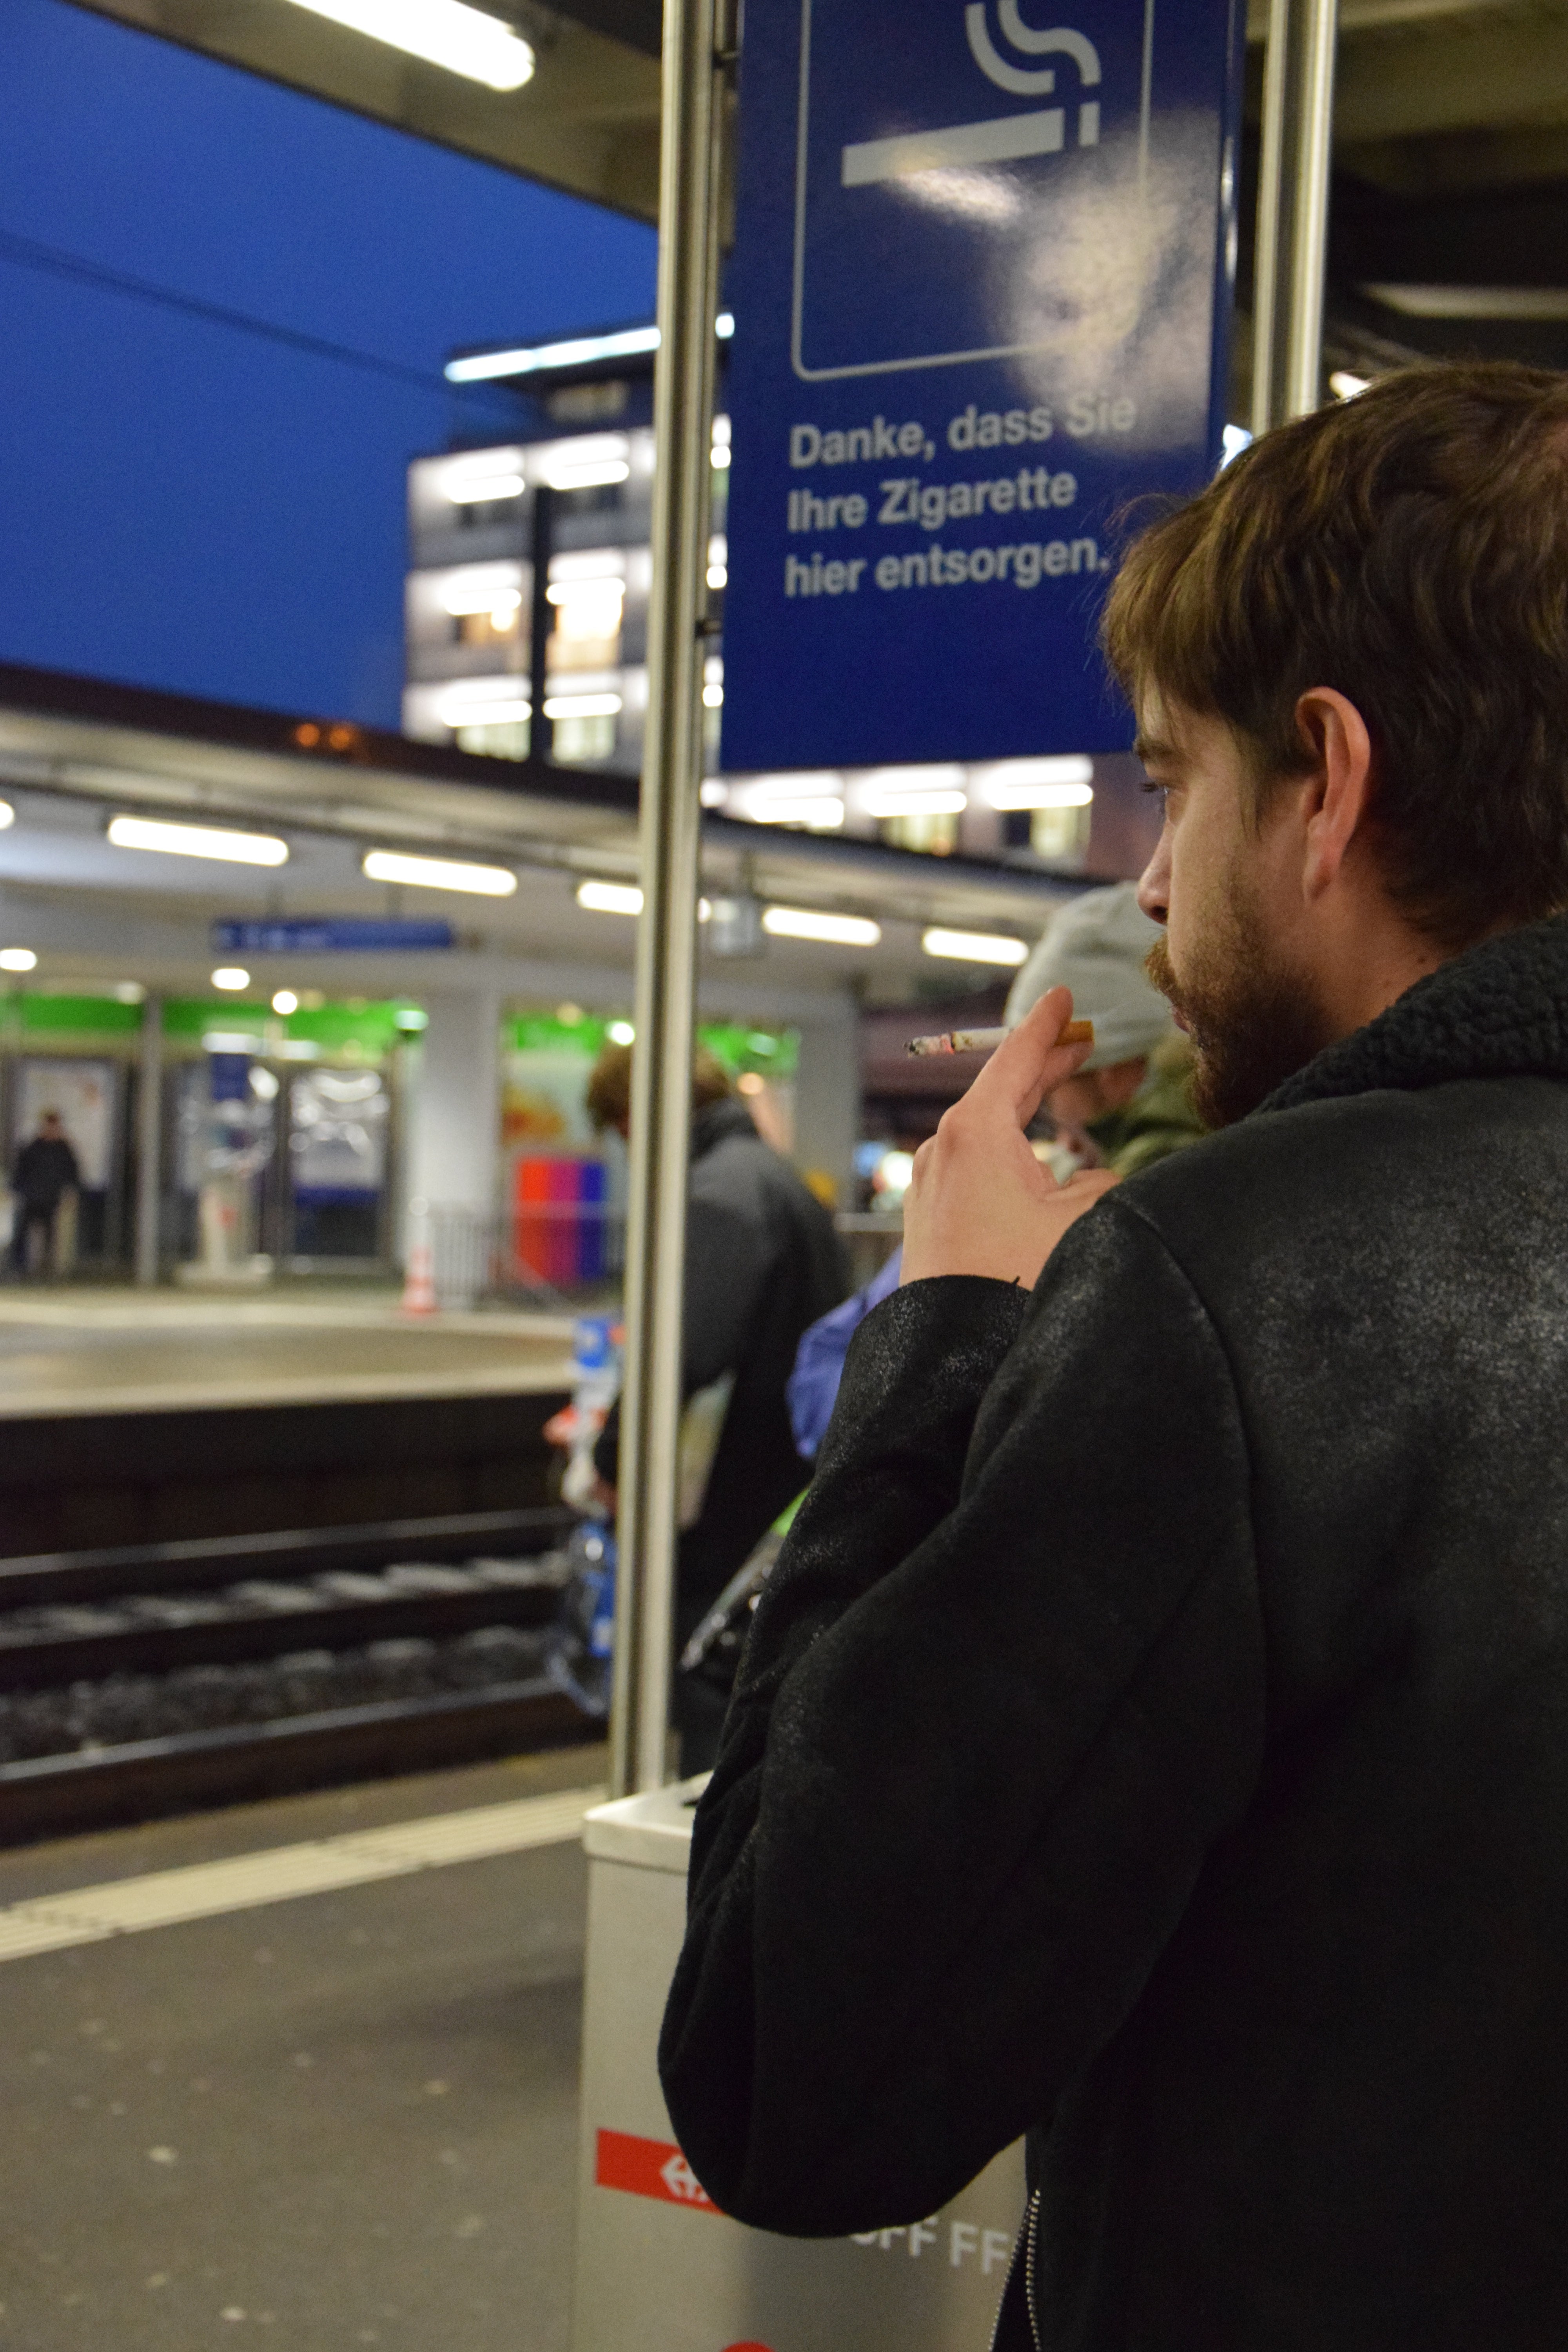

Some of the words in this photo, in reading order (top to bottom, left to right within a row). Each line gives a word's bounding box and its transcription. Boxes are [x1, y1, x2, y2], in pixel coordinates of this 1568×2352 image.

[789, 416, 936, 468] Danke,
[947, 405, 1054, 450] dass
[1065, 392, 1138, 436] Sie
[788, 489, 868, 532] Ihre
[877, 466, 1078, 530] Zigarette
[785, 553, 867, 597] hier
[875, 537, 1111, 588] entsorgen.
